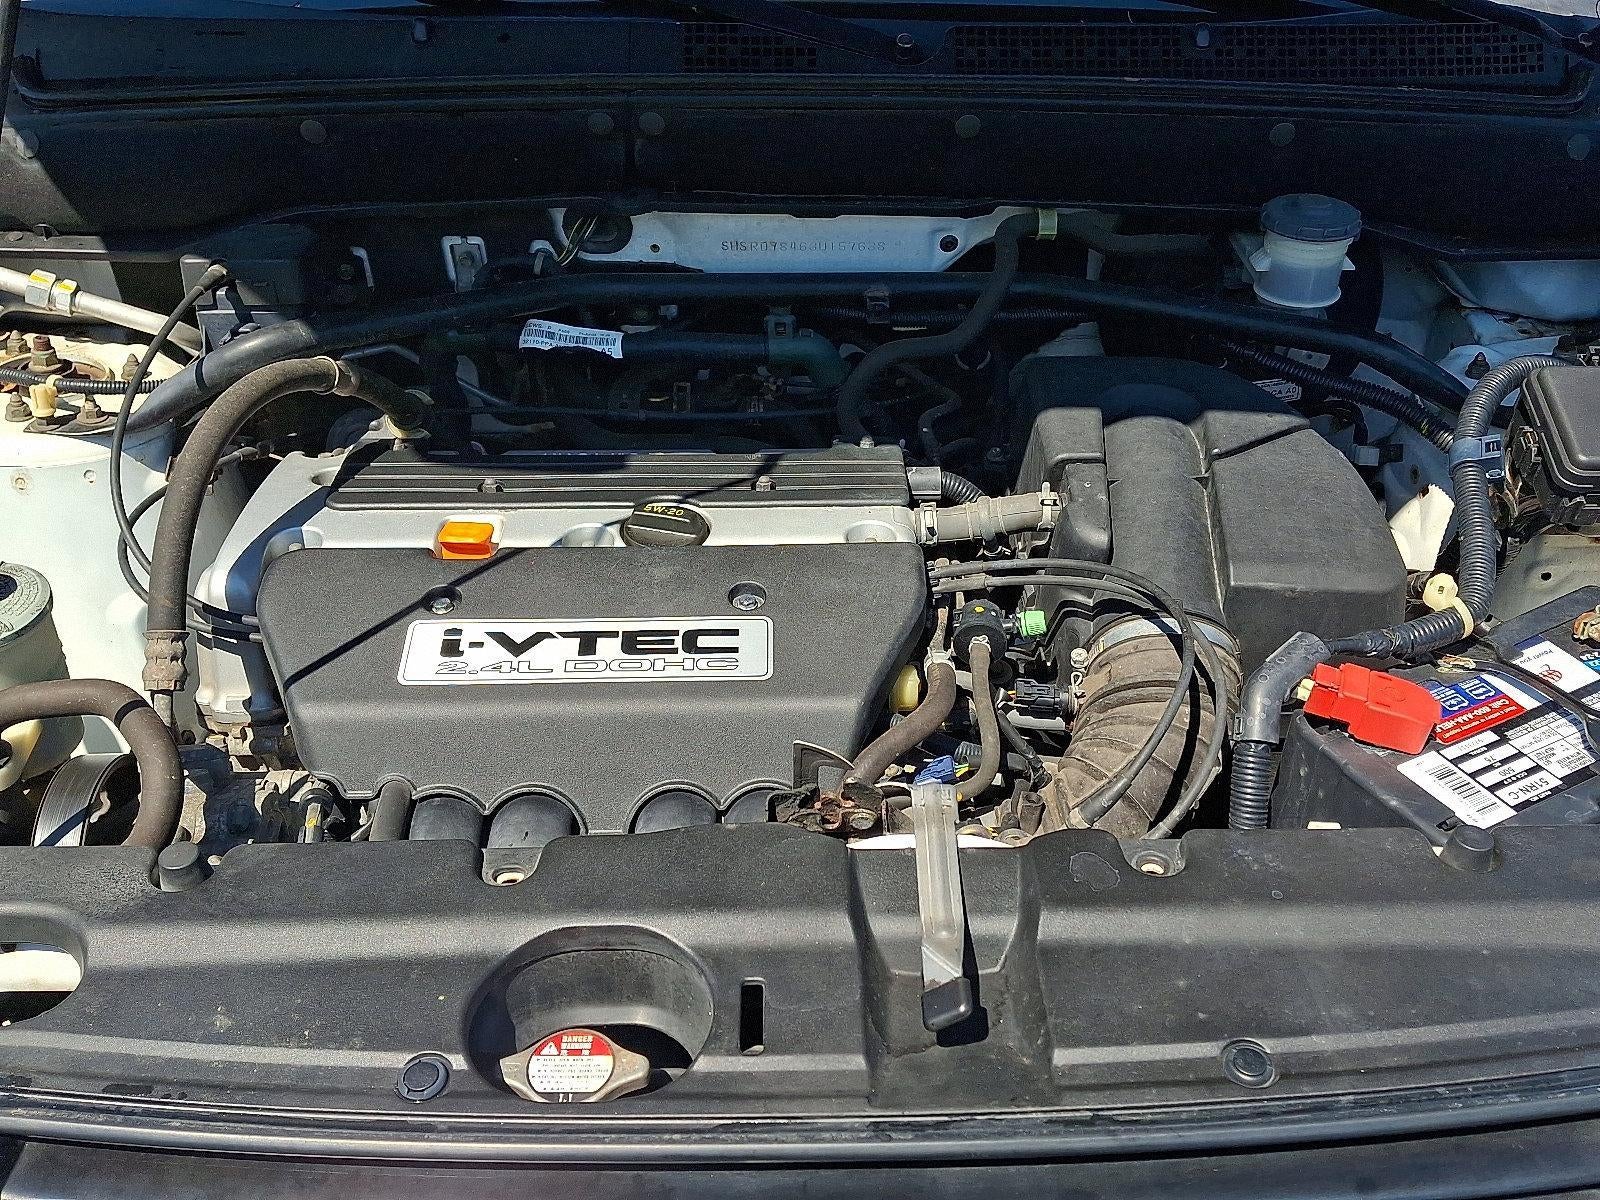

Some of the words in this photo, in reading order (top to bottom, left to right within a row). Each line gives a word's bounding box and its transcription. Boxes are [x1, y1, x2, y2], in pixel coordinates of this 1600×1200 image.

[643, 504, 684, 516] 5W-20
[440, 628, 740, 658] i-VTEC
[435, 660, 553, 675] 2.4L
[564, 657, 739, 674] DOHC
[1508, 778, 1549, 800] 51RN-C
